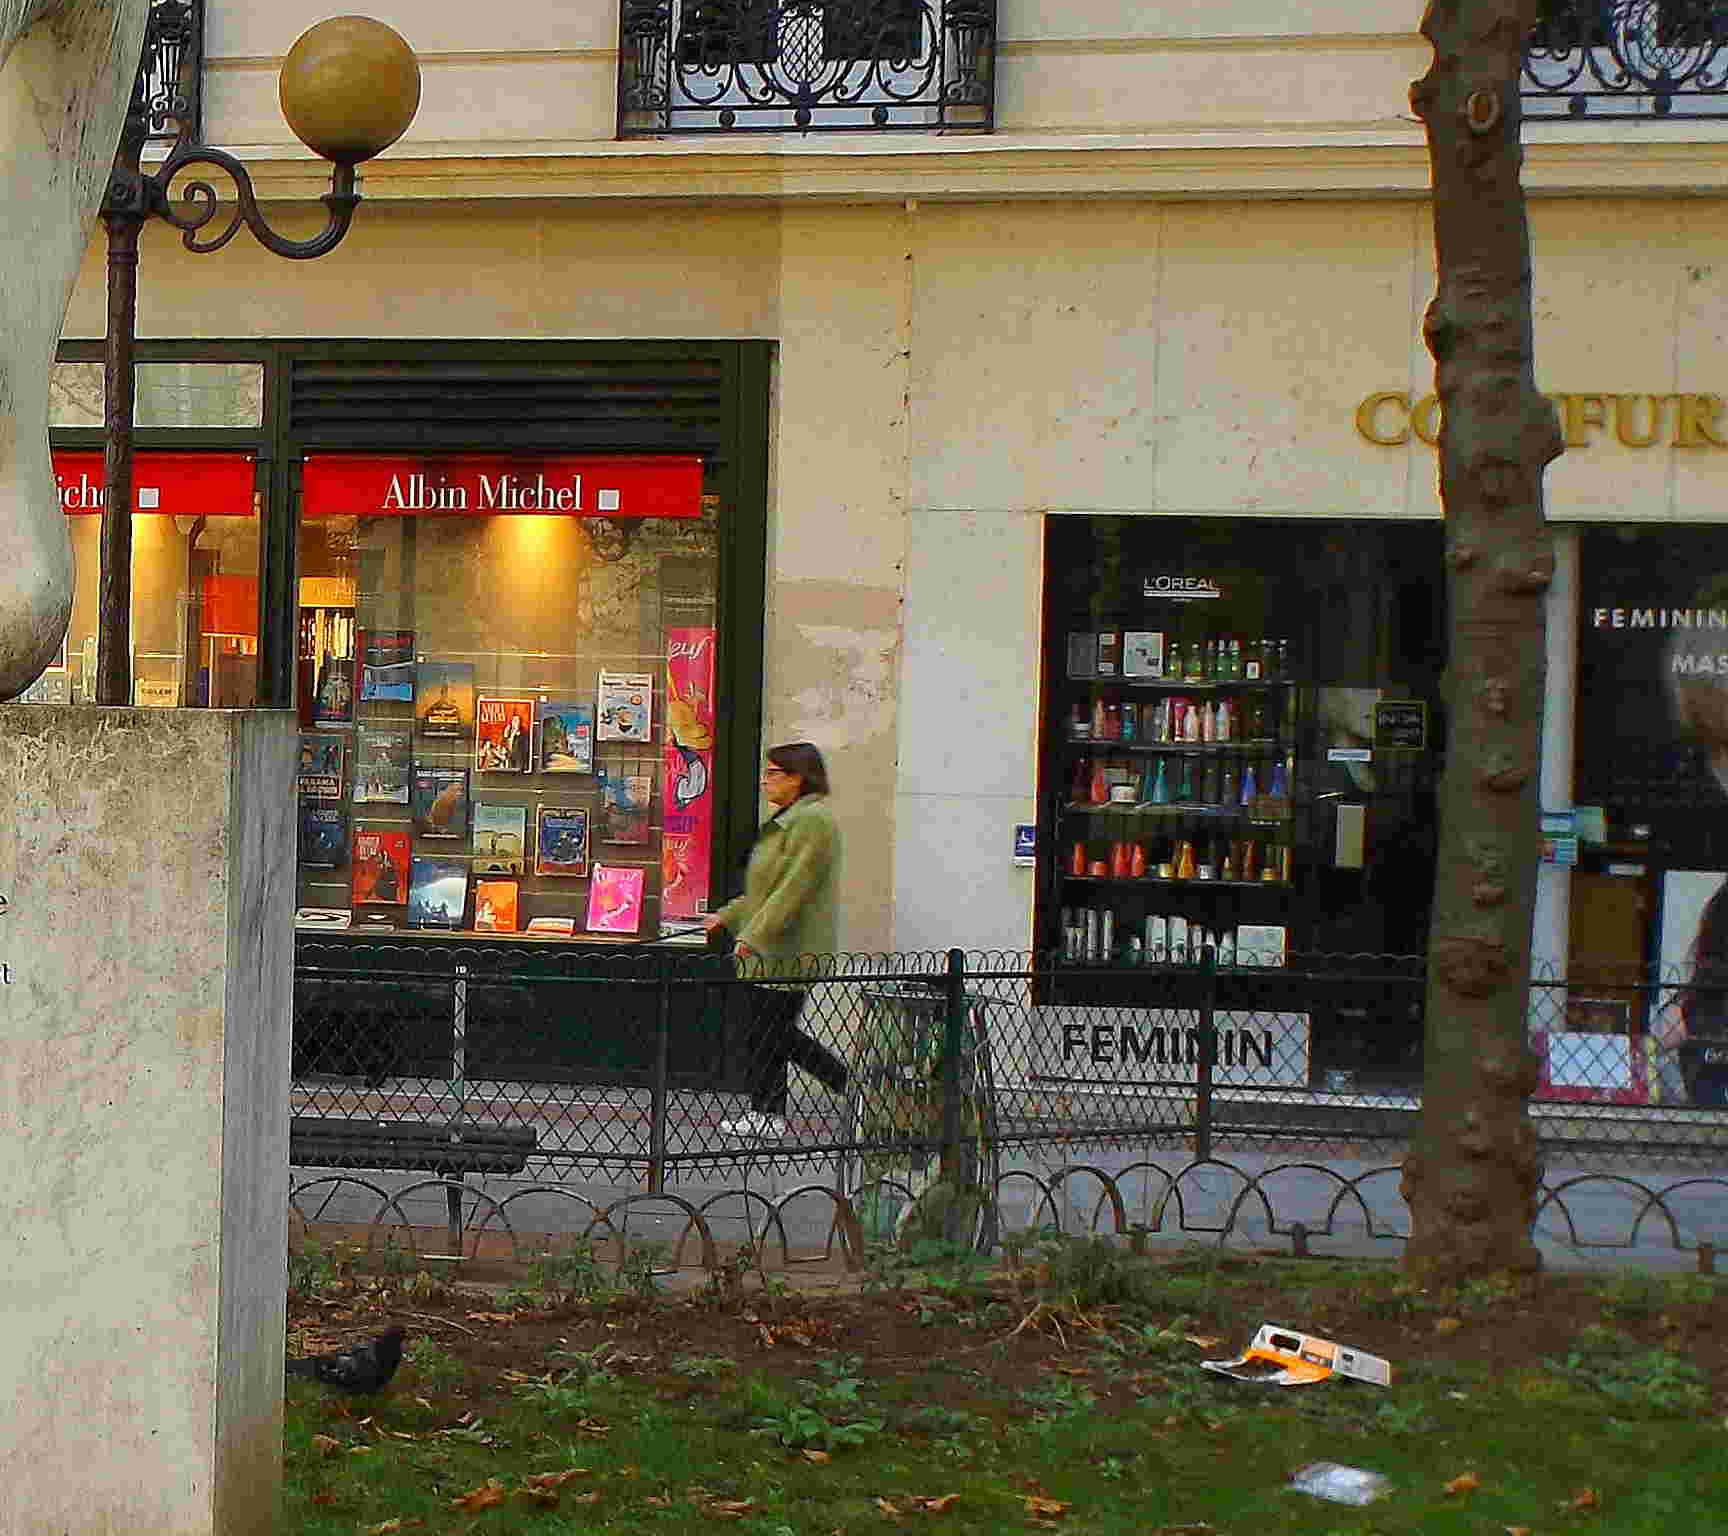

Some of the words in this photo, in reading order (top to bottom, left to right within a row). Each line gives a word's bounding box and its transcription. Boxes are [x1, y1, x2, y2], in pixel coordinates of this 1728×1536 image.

[1355, 391, 1728, 449] COFUR
[380, 473, 469, 510] Albin
[476, 473, 584, 511] Michel
[1063, 1023, 1272, 1066] FEMININ
